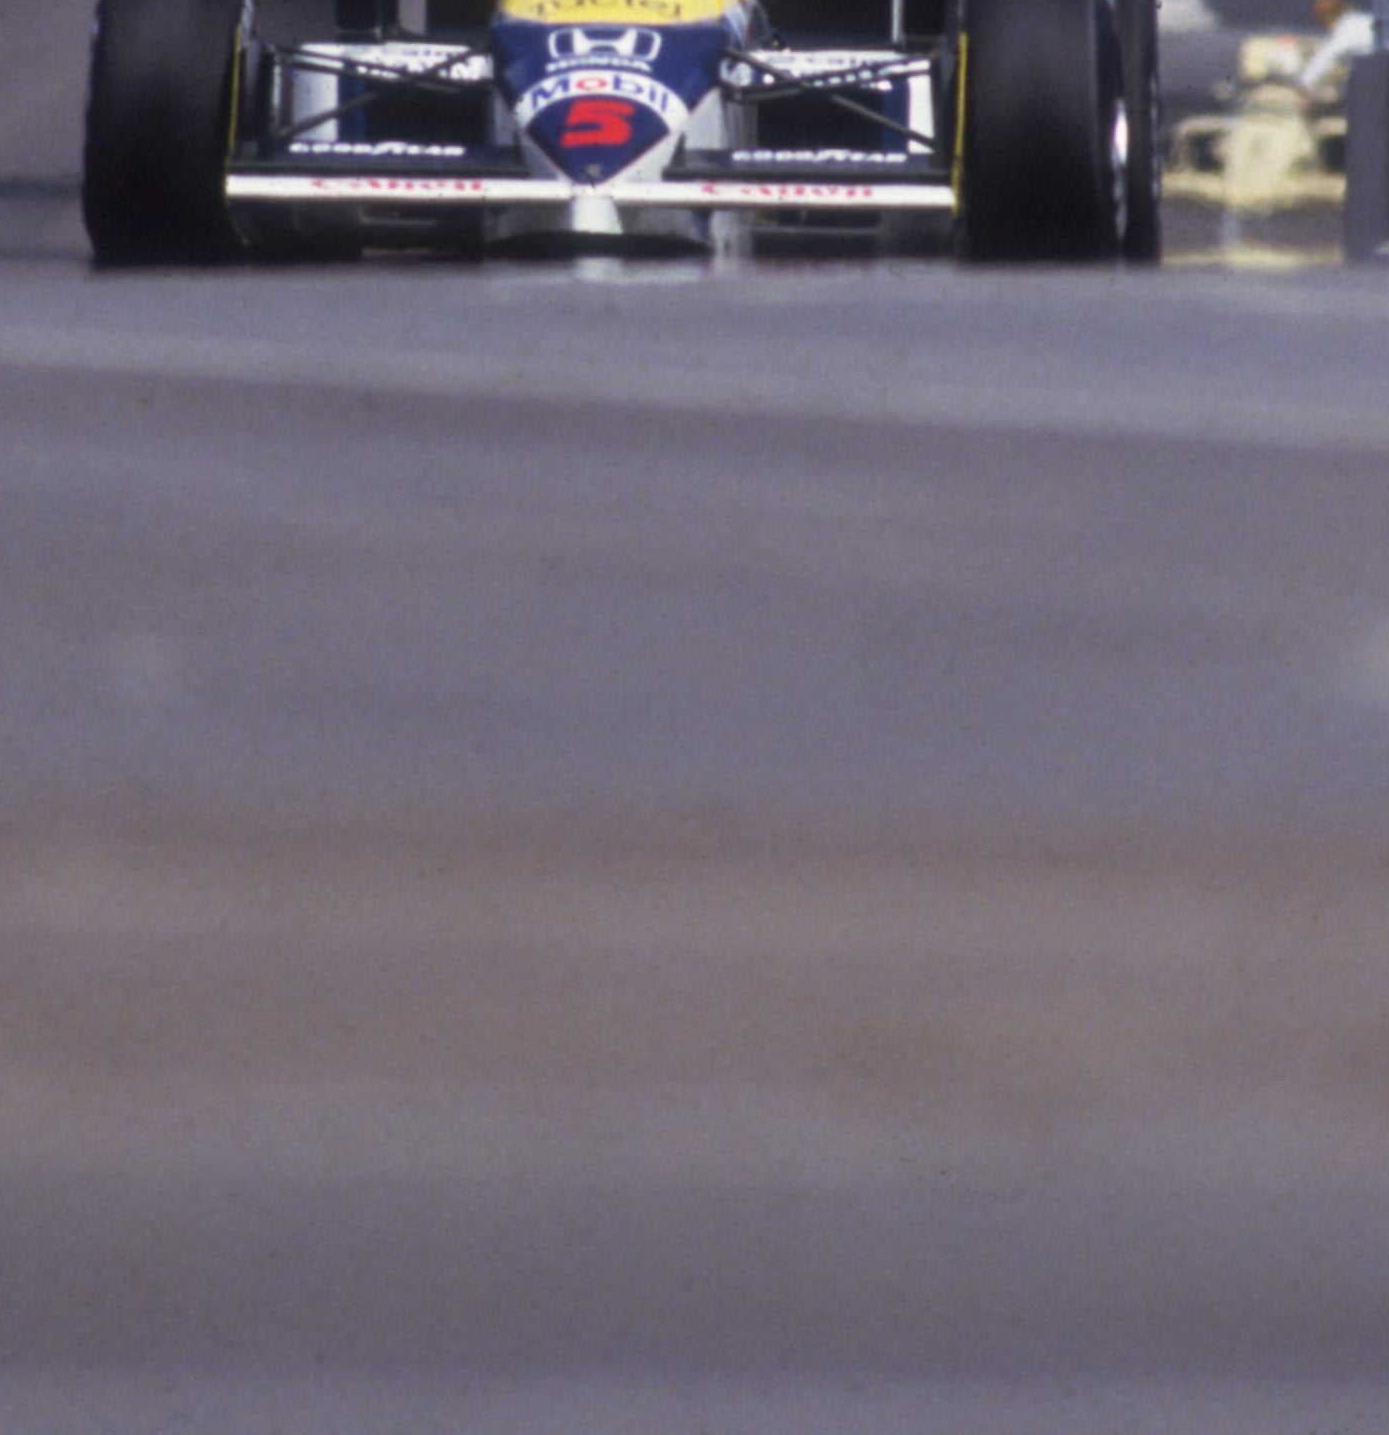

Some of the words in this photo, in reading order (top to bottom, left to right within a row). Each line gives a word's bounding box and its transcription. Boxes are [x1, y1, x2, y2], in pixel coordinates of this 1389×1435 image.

[531, 75, 670, 111] Mobil
[560, 98, 636, 149] 5
[289, 141, 465, 157] GOODYEAR
[731, 148, 908, 164] GOODYEAR
